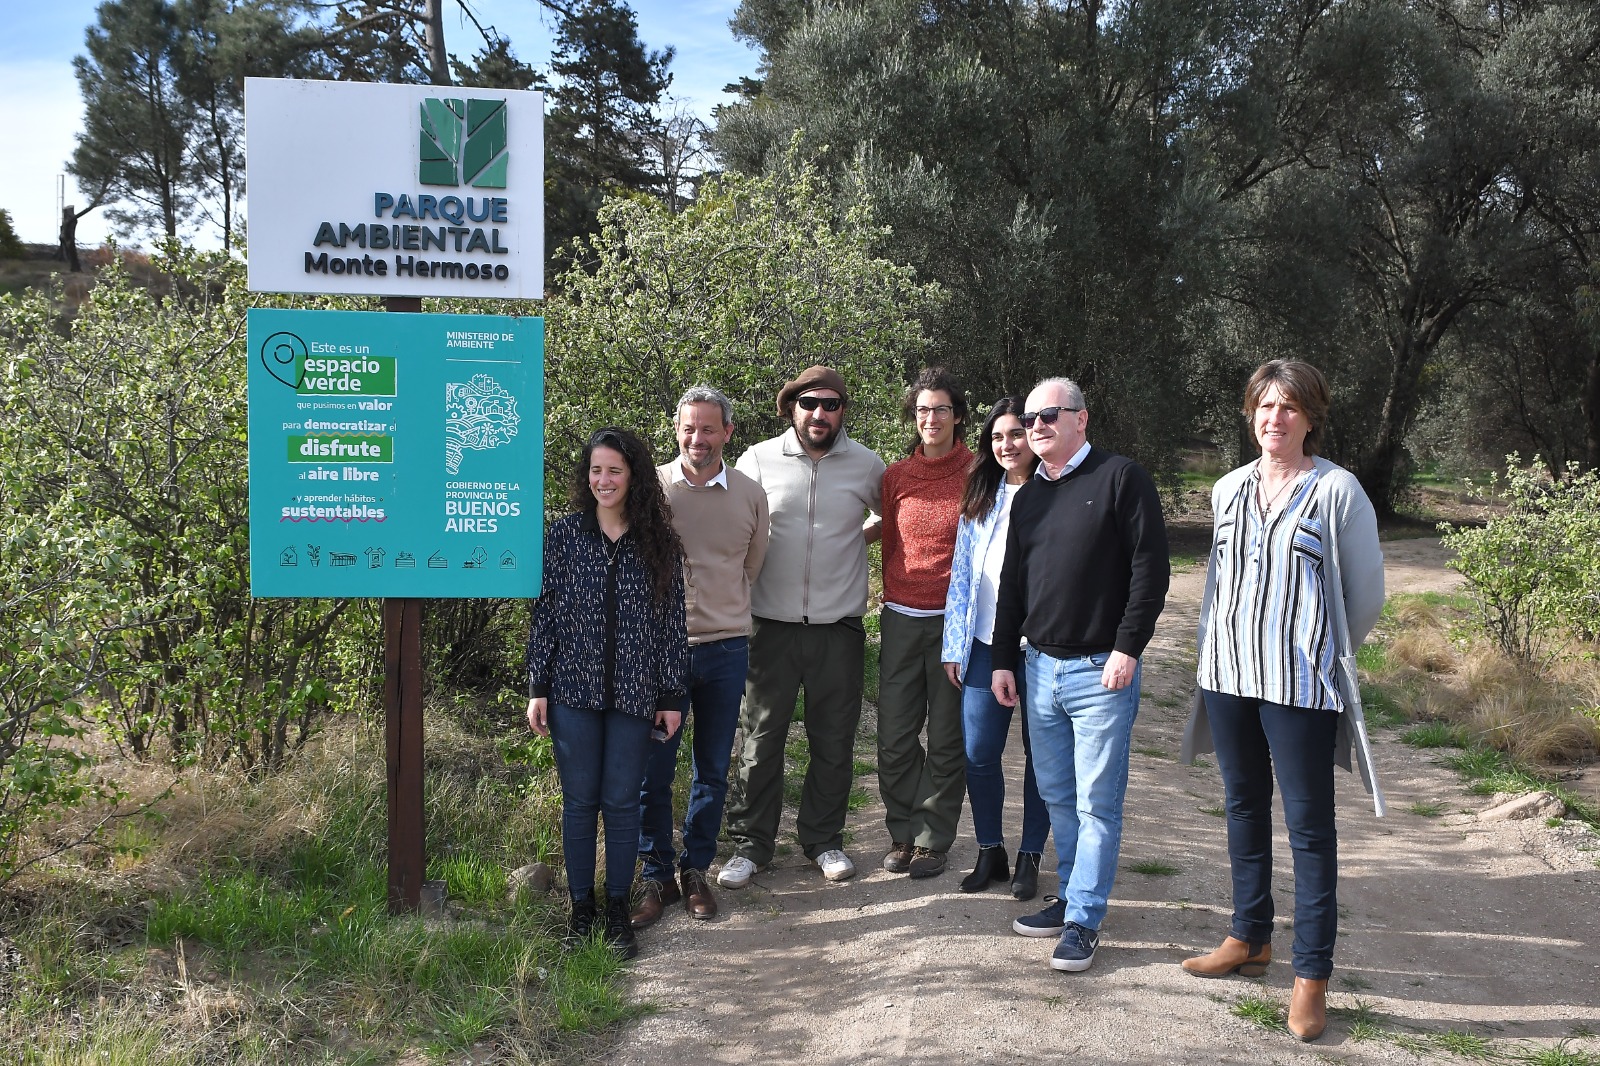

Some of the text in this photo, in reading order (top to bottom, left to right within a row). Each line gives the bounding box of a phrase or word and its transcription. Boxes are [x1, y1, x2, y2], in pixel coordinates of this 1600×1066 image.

[374, 192, 508, 225] PARQUE
[313, 221, 509, 254] AMBIENTAL
[304, 251, 509, 281] Monte Hermoso
[446, 331, 514, 341] MINISTERIO DE
[311, 342, 369, 354] Este es un
[446, 340, 494, 349] AMBIENTE
[304, 356, 380, 376] espacio
[303, 373, 361, 391] verde
[296, 402, 311, 410] que
[313, 401, 345, 410] pusimos
[358, 399, 392, 411] valor
[282, 419, 396, 431] para democratizar el
[300, 438, 381, 457] disfrute
[298, 466, 379, 481] al aire libre
[445, 481, 492, 490] GOBIERNO
[494, 482, 506, 490] DE
[296, 494, 376, 503] y aprender hábitos
[445, 491, 508, 500] PROVINCIA DE
[281, 504, 385, 518] sustentables
[445, 501, 520, 516] BUENOS
[445, 518, 498, 533] AIRES
